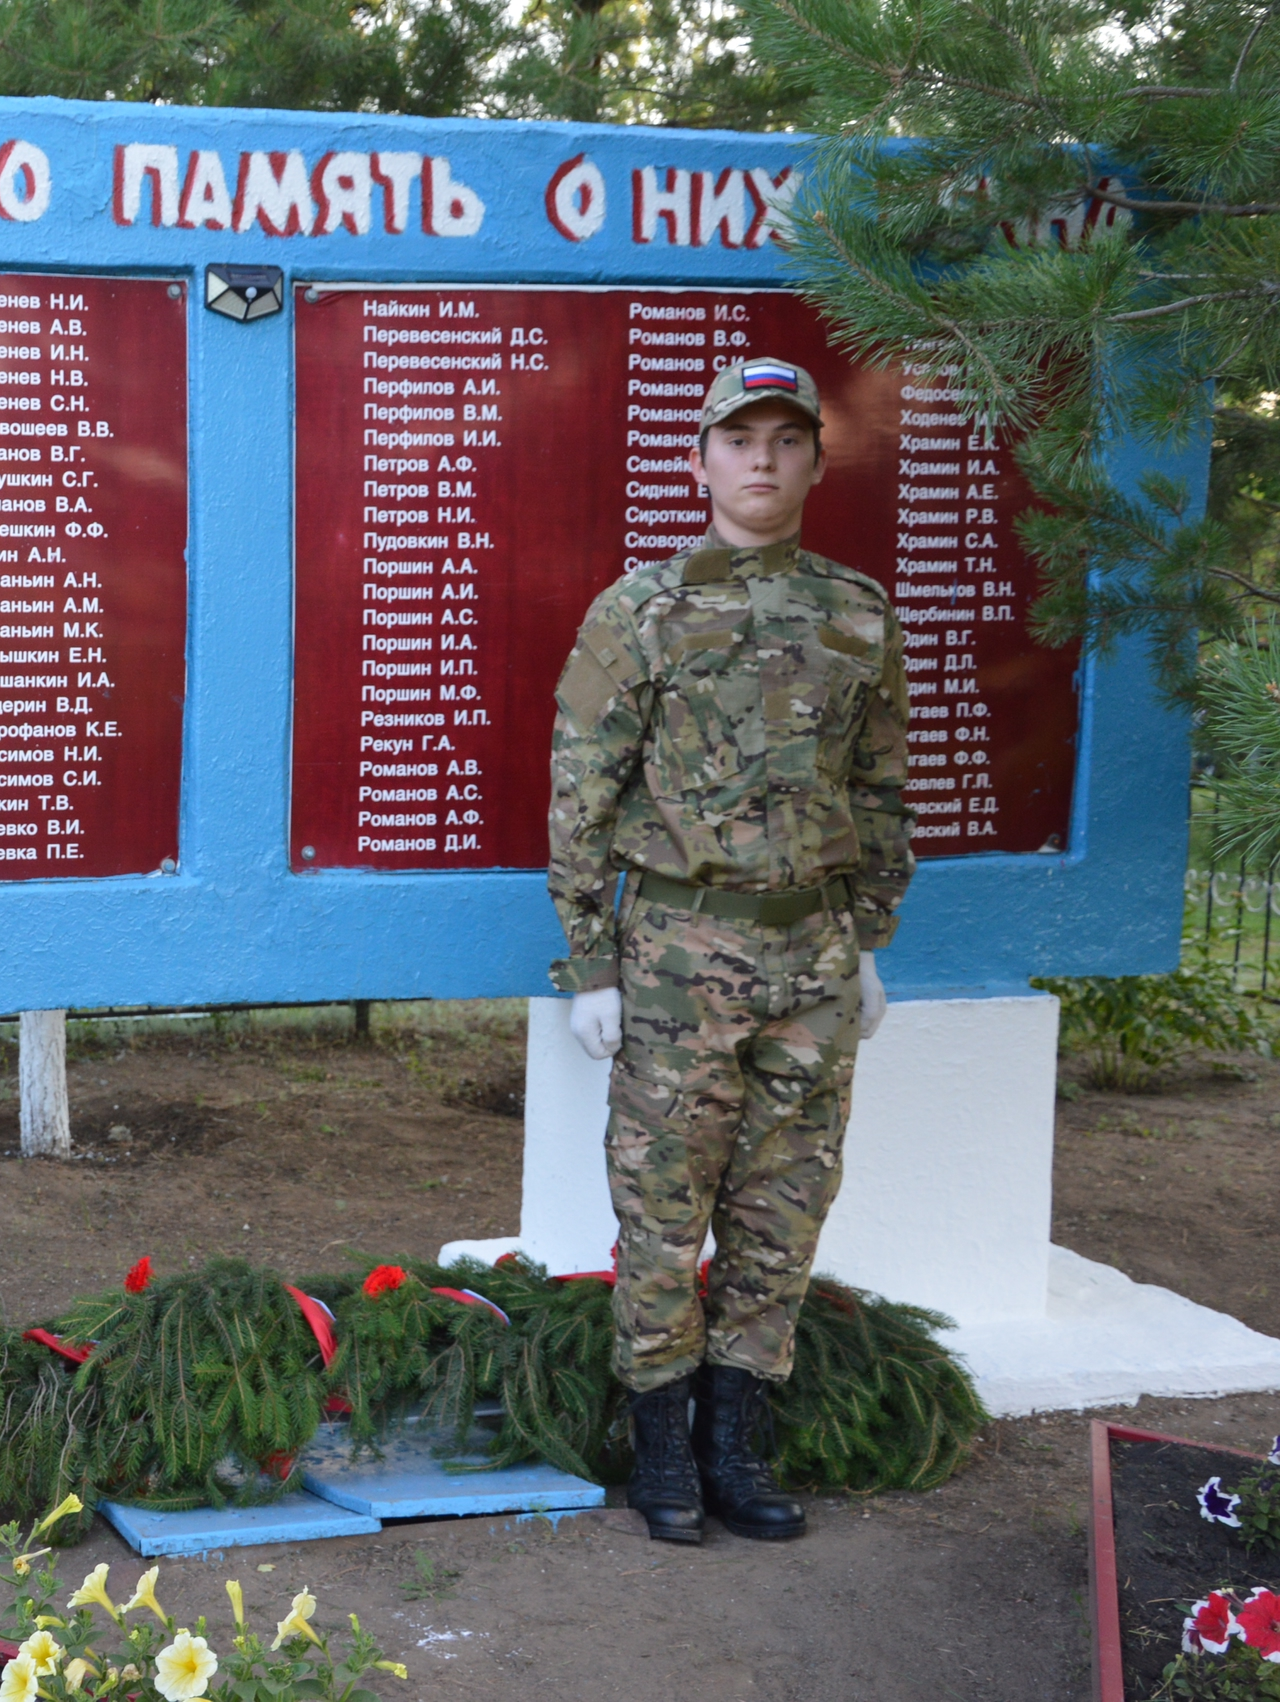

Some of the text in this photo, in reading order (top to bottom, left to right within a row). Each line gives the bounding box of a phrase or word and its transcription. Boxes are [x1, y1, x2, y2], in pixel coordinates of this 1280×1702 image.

[112, 143, 486, 238] ПАМЯТЬ
[545, 152, 605, 243] О
[631, 164, 803, 249] НИХ
[49, 292, 89, 311] Н.И.
[363, 299, 480, 318] Найкин И.М.
[629, 301, 750, 322] Романов И.С.
[49, 318, 87, 337] А.В.
[363, 325, 548, 347] Перевесенский Д.С.
[628, 327, 751, 347] Романов В.Ф.
[50, 343, 90, 362] И.Н.
[363, 350, 549, 372] Перевесенский Н.С.
[628, 353, 705, 372] Романов
[50, 368, 89, 387] Н.В.
[363, 376, 501, 398] Перфилов А.И.
[627, 378, 703, 397] Романов
[363, 402, 503, 424] Перфилов В.М.
[627, 404, 702, 423] Романов
[77, 420, 114, 438] В.В.
[899, 433, 961, 454] Храмин
[50, 444, 86, 463] В.Г.
[363, 454, 477, 476] Петров А.Ф.
[898, 458, 1000, 479] Храмин И.А.
[61, 470, 99, 488] С.Г.
[363, 480, 477, 501] Петров В.М.
[625, 480, 689, 500] Сиднин
[897, 482, 999, 504] Храмин А.Е.
[55, 495, 93, 513] В.А.
[363, 505, 476, 527] Петров Н.И.
[624, 505, 706, 527] Сироткин
[896, 507, 998, 528] Храмин Р.В.
[64, 521, 109, 539] Ф.Ф.
[363, 531, 495, 553] Пудовкин В.Н.
[896, 531, 999, 553] Храмин С.А.
[27, 546, 67, 563] А.Н.
[363, 557, 479, 578] Поршин А.А.
[895, 556, 997, 577] Храмин Т.Н.
[63, 571, 103, 588] А.Н.
[982, 580, 1016, 598] В.Н.
[363, 582, 479, 604] Поршин А.И.
[362, 607, 479, 629] Поршин А.С.
[894, 604, 1015, 625] Щербинин В.П.
[63, 621, 104, 639] М.К.
[68, 646, 107, 663] Е.Н.
[361, 658, 478, 680] Поршин И.П.
[77, 671, 116, 688] И.А.
[944, 677, 980, 694] М.И.
[361, 683, 482, 705] Поршин М.Ф.
[56, 696, 93, 715] В.Д.
[956, 701, 992, 718] П.Ф.
[360, 708, 492, 727] Резников И.П.
[85, 720, 123, 737] К.Е.
[954, 725, 990, 742] Ф.Н.
[360, 734, 456, 756] Рекун Г.А.
[359, 758, 483, 778] Романов А.В.
[62, 769, 102, 787] С.И.
[37, 794, 74, 811] Т.В.
[47, 818, 85, 836] В.И.
[358, 808, 484, 828] Романов А.Ф.
[46, 842, 85, 860] П.Е.
[357, 833, 482, 853] Романов Д.И.
